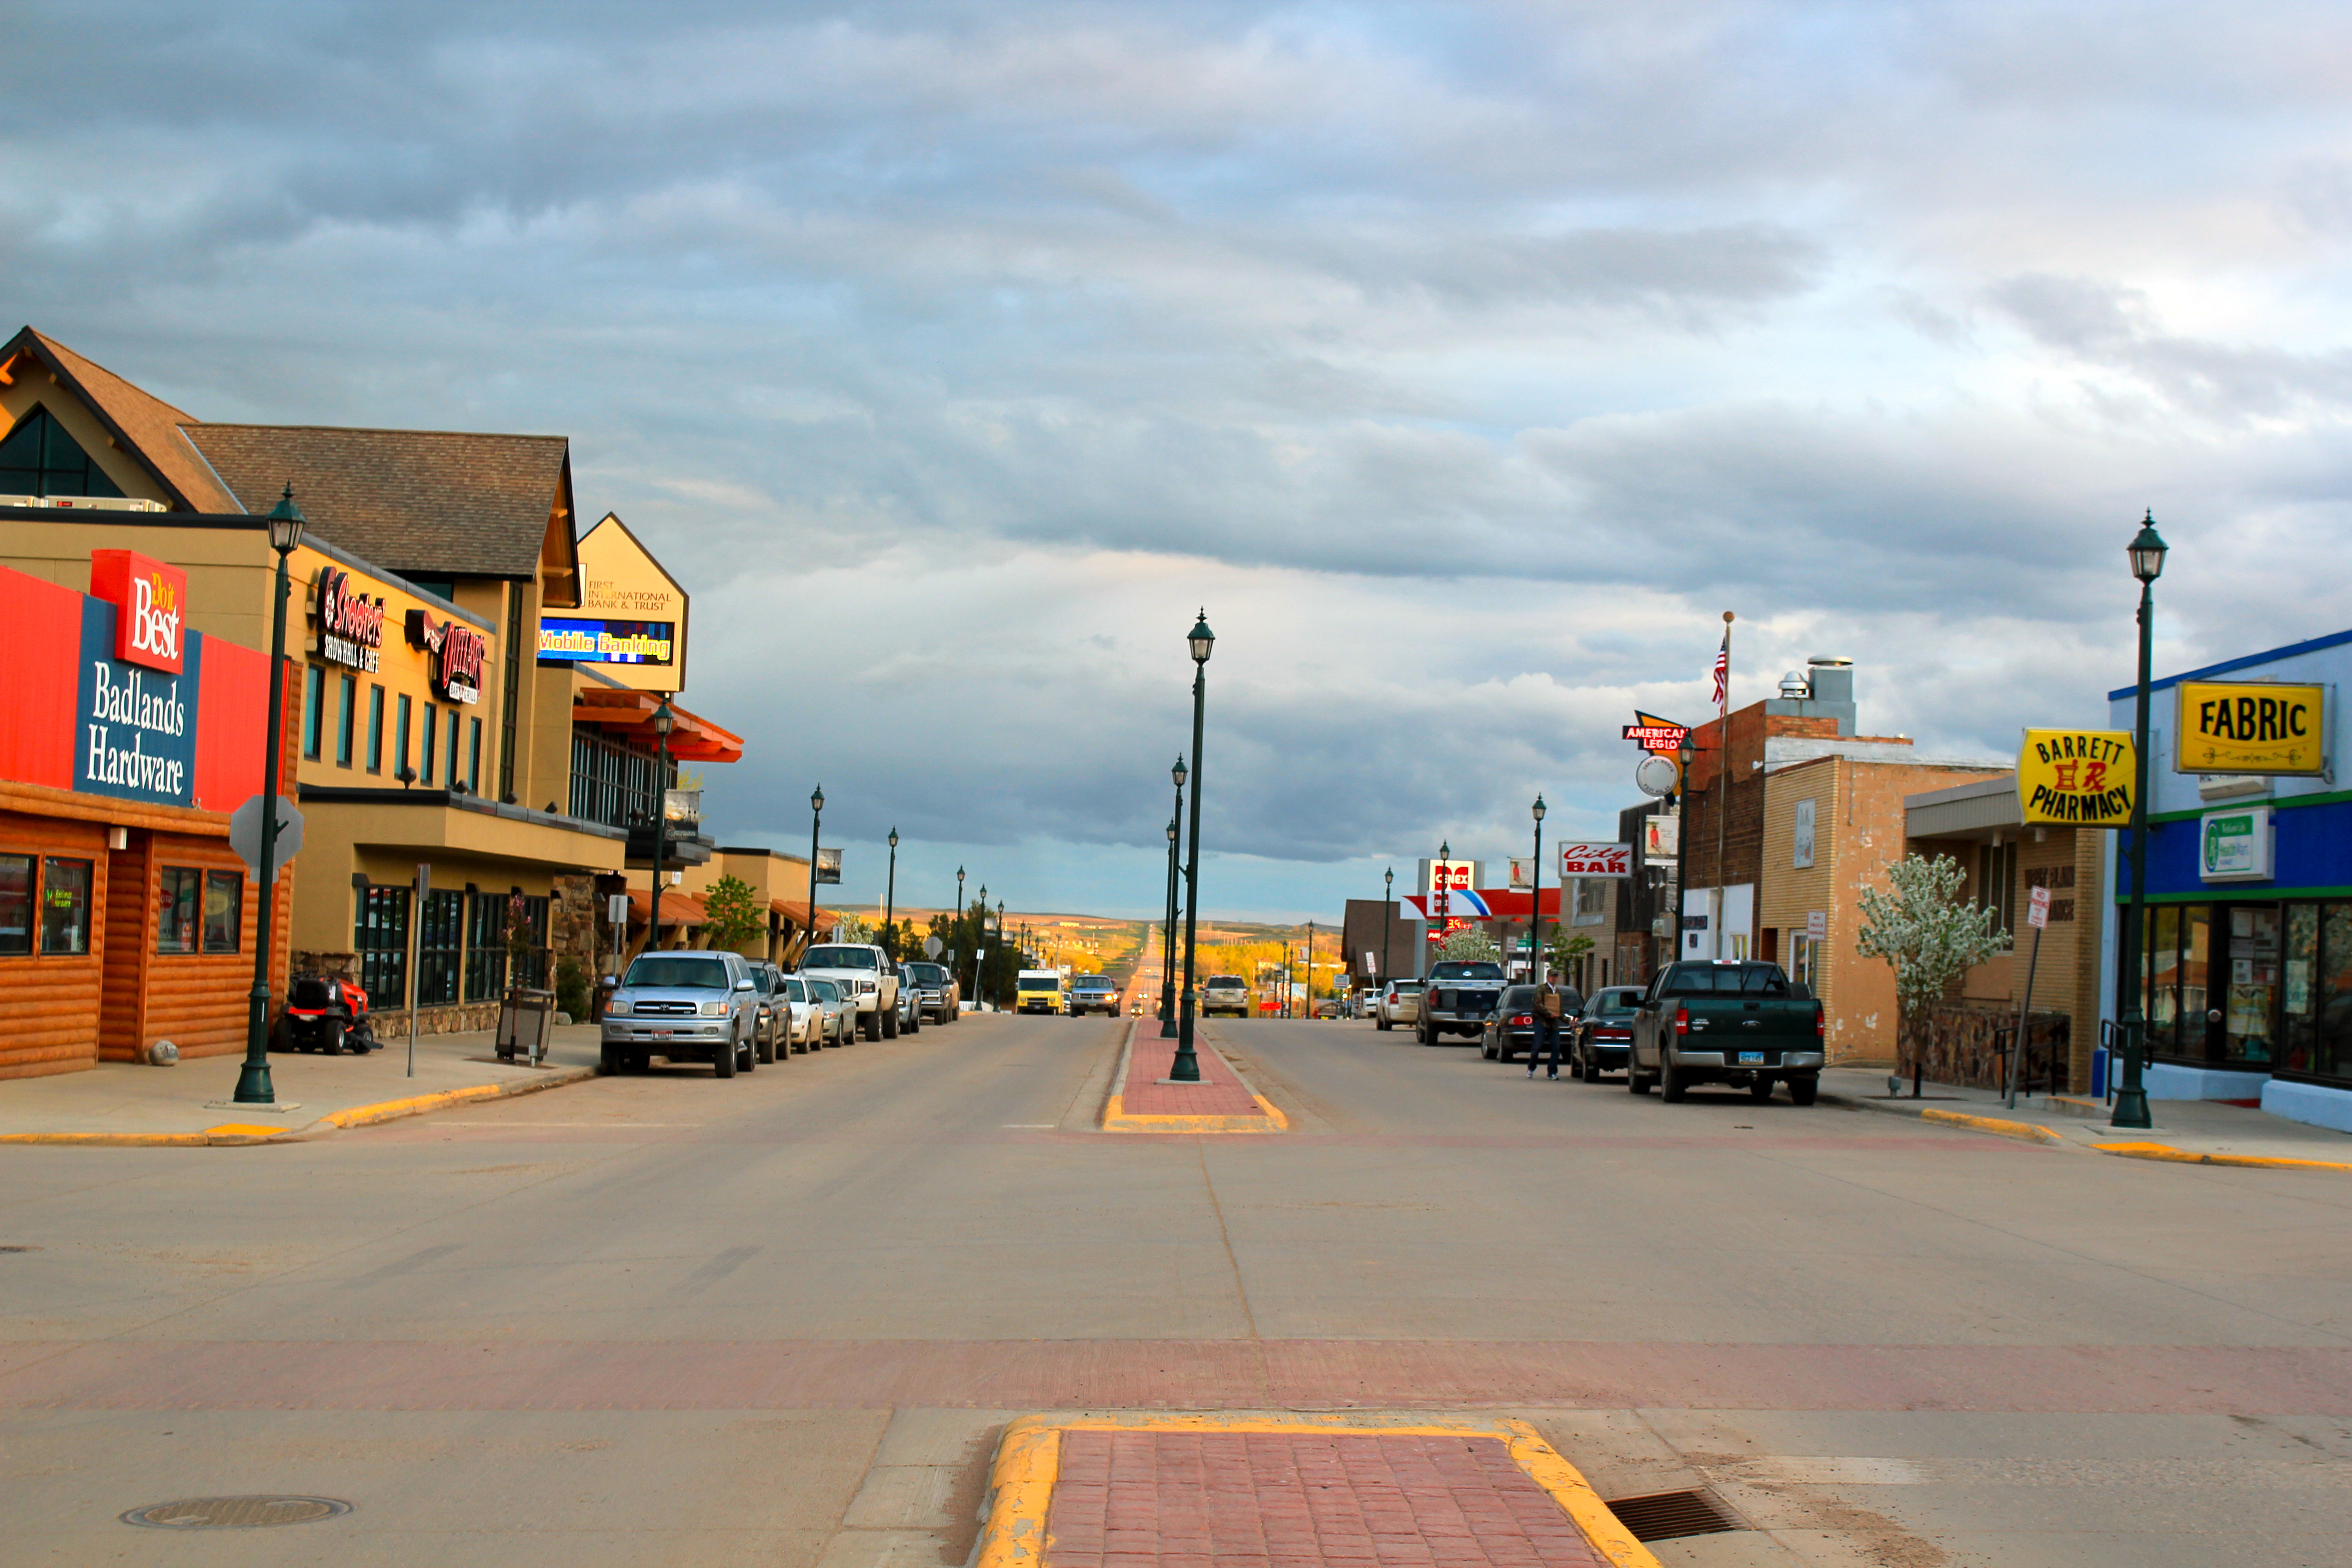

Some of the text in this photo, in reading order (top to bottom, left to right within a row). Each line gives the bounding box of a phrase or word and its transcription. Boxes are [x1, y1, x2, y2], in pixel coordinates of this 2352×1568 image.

[151, 572, 167, 608] Do
[588, 590, 671, 603] INTERNATIONAL
[589, 581, 614, 590] FIRST
[132, 577, 180, 660] Best
[588, 600, 666, 611] BANK & TRUST
[539, 630, 671, 661] Mobile Banking
[359, 647, 364, 669] &
[365, 649, 379, 674] CAFE
[93, 661, 185, 737] Badlands
[464, 689, 476, 702] GRILL
[2200, 696, 2307, 741] FABRIC
[1643, 738, 1682, 750] LEGIO
[2035, 735, 2125, 765] BARRETT
[87, 723, 184, 795] Hardware
[2029, 784, 2132, 821] PHARMACY
[1563, 845, 1630, 862] City
[1567, 861, 1626, 873] BAR
